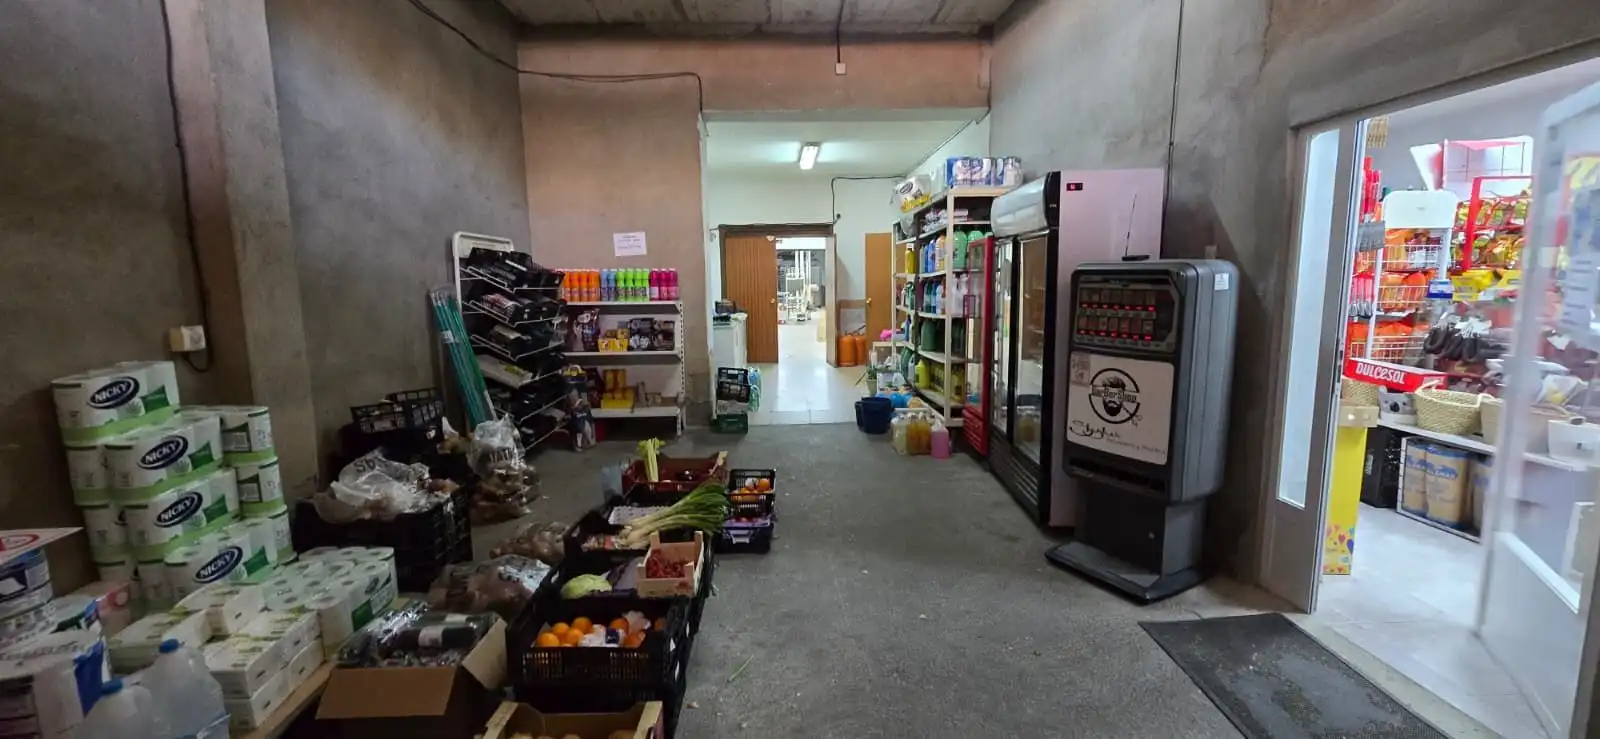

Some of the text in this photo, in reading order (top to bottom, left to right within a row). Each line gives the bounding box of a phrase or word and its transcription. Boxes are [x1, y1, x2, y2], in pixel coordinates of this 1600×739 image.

[94, 382, 128, 402] NICKY
[144, 441, 178, 464] NICKY
[161, 497, 193, 521] NICKY
[200, 551, 234, 577] NICKY
